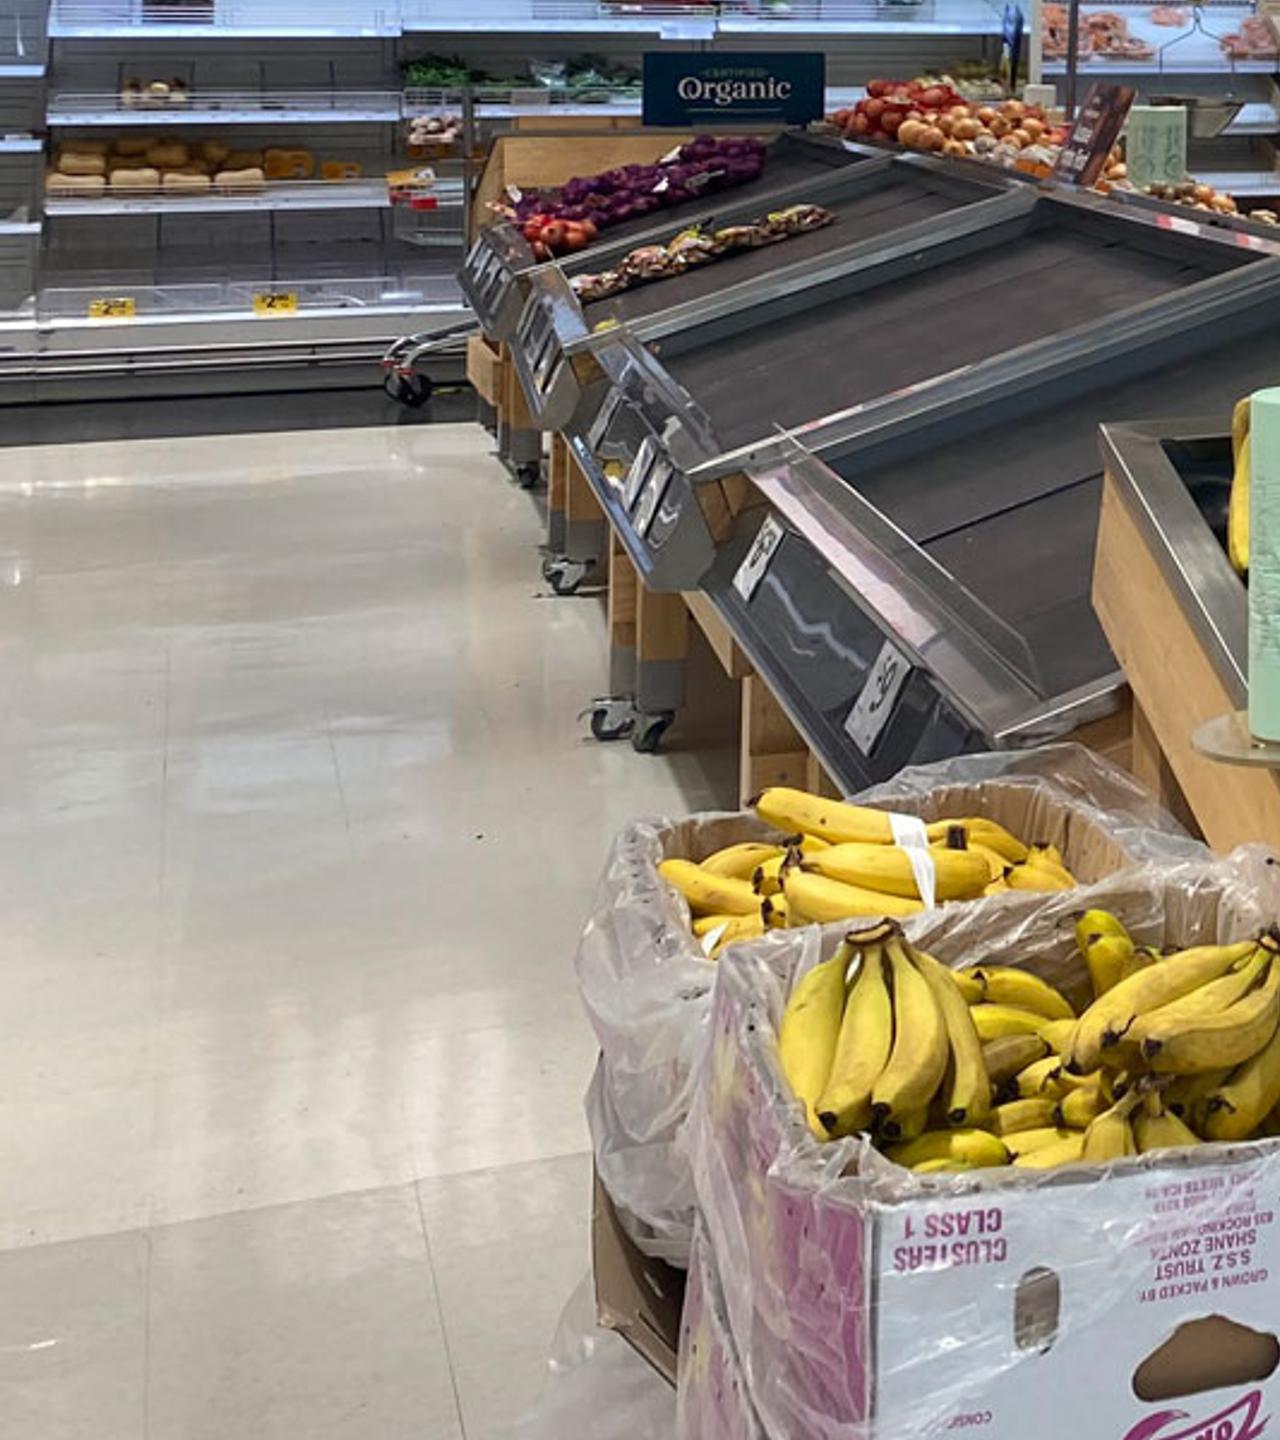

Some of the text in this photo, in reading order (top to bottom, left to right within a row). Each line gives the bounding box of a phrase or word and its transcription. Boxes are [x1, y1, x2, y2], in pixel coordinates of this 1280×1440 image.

[677, 76, 792, 106] Organic
[904, 1207, 1003, 1239] CLASS 1
[1205, 1228, 1257, 1252] SHANE
[894, 1237, 1007, 1271] CLUSTERS
[1155, 1258, 1206, 1281] TRUST
[1222, 1269, 1268, 1287] GROWN
[1159, 1279, 1208, 1300] PACKED
